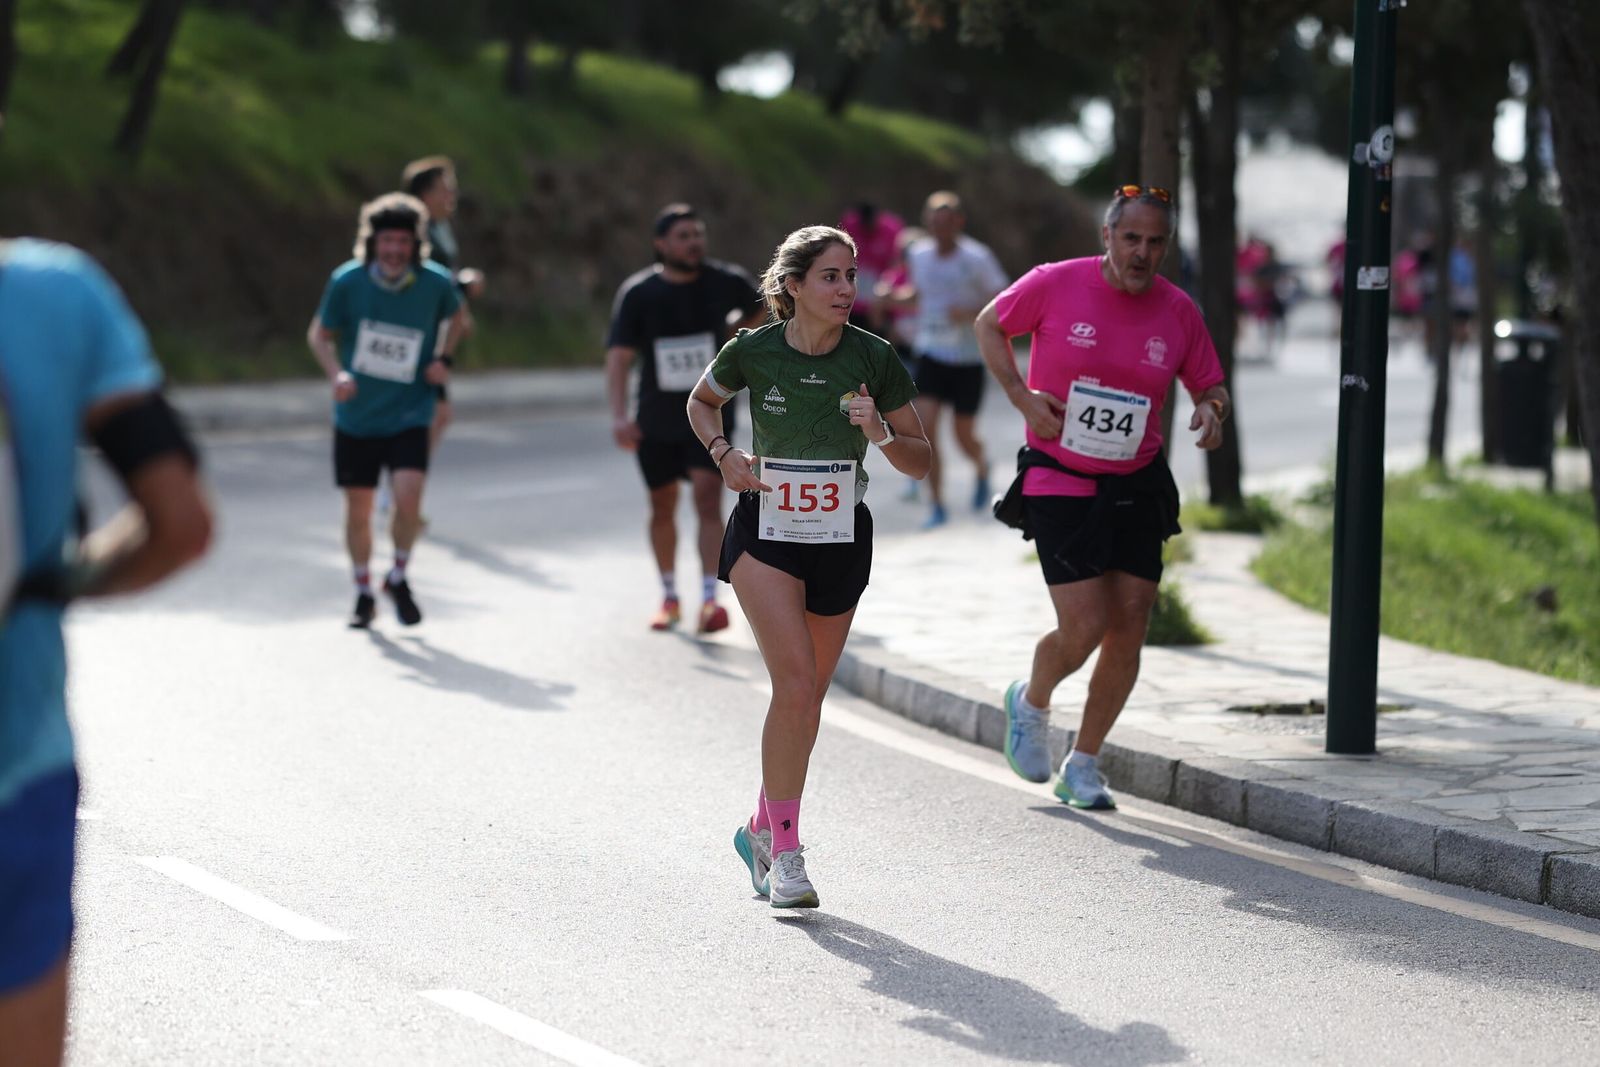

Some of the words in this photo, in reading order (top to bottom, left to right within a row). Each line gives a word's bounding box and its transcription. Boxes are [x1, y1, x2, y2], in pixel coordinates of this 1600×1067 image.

[763, 402, 787, 413] ODEON
[1078, 405, 1134, 437] 434
[778, 482, 840, 513] 153
